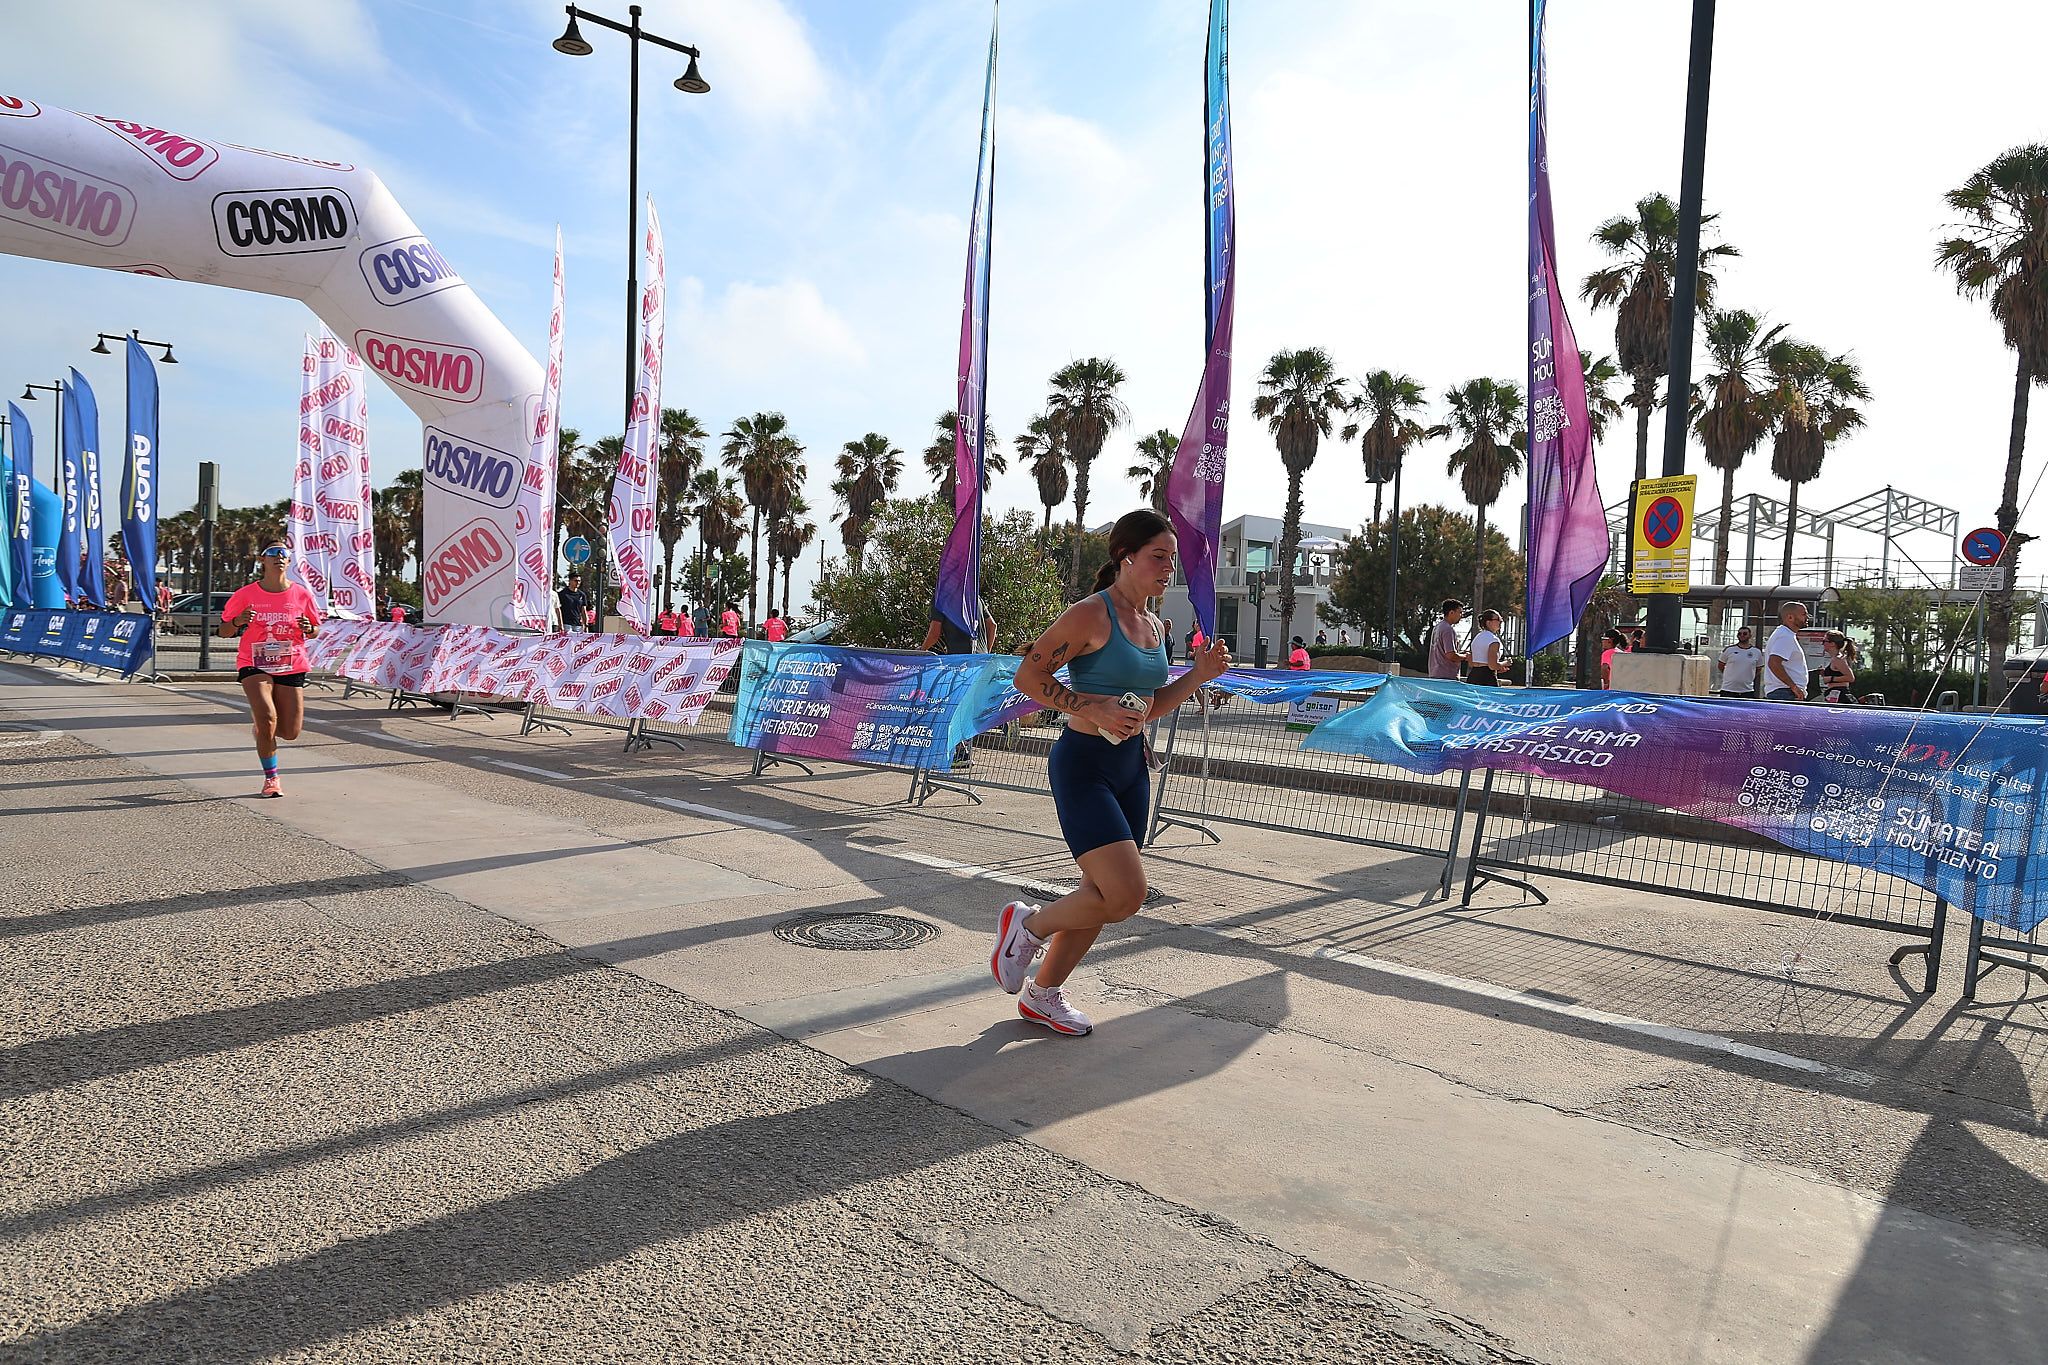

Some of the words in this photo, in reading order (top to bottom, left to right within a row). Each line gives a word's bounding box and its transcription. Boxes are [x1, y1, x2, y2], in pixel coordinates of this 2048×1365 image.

[226, 194, 348, 247] COSMO
[373, 243, 458, 294] COSM
[365, 338, 473, 394] COSMO
[425, 435, 514, 498] COSMO
[424, 527, 502, 606] COSMO
[574, 647, 603, 670] COSMO
[595, 655, 624, 673] COSMO
[654, 654, 684, 683] COSMO
[558, 683, 586, 698] COSMO
[593, 678, 622, 699] COSMO
[665, 676, 695, 693] COSMO
[798, 681, 810, 694] EL
[680, 692, 712, 709] COSMO
[792, 701, 806, 715] DE
[803, 701, 831, 718] MAMA
[759, 716, 819, 738] METASTÁSICO
[1564, 726, 1642, 748] MAMA
[1893, 806, 1983, 852] SÚMATE
[1980, 841, 2003, 861] AL
[1885, 827, 1998, 880] MOVIMIENTO
